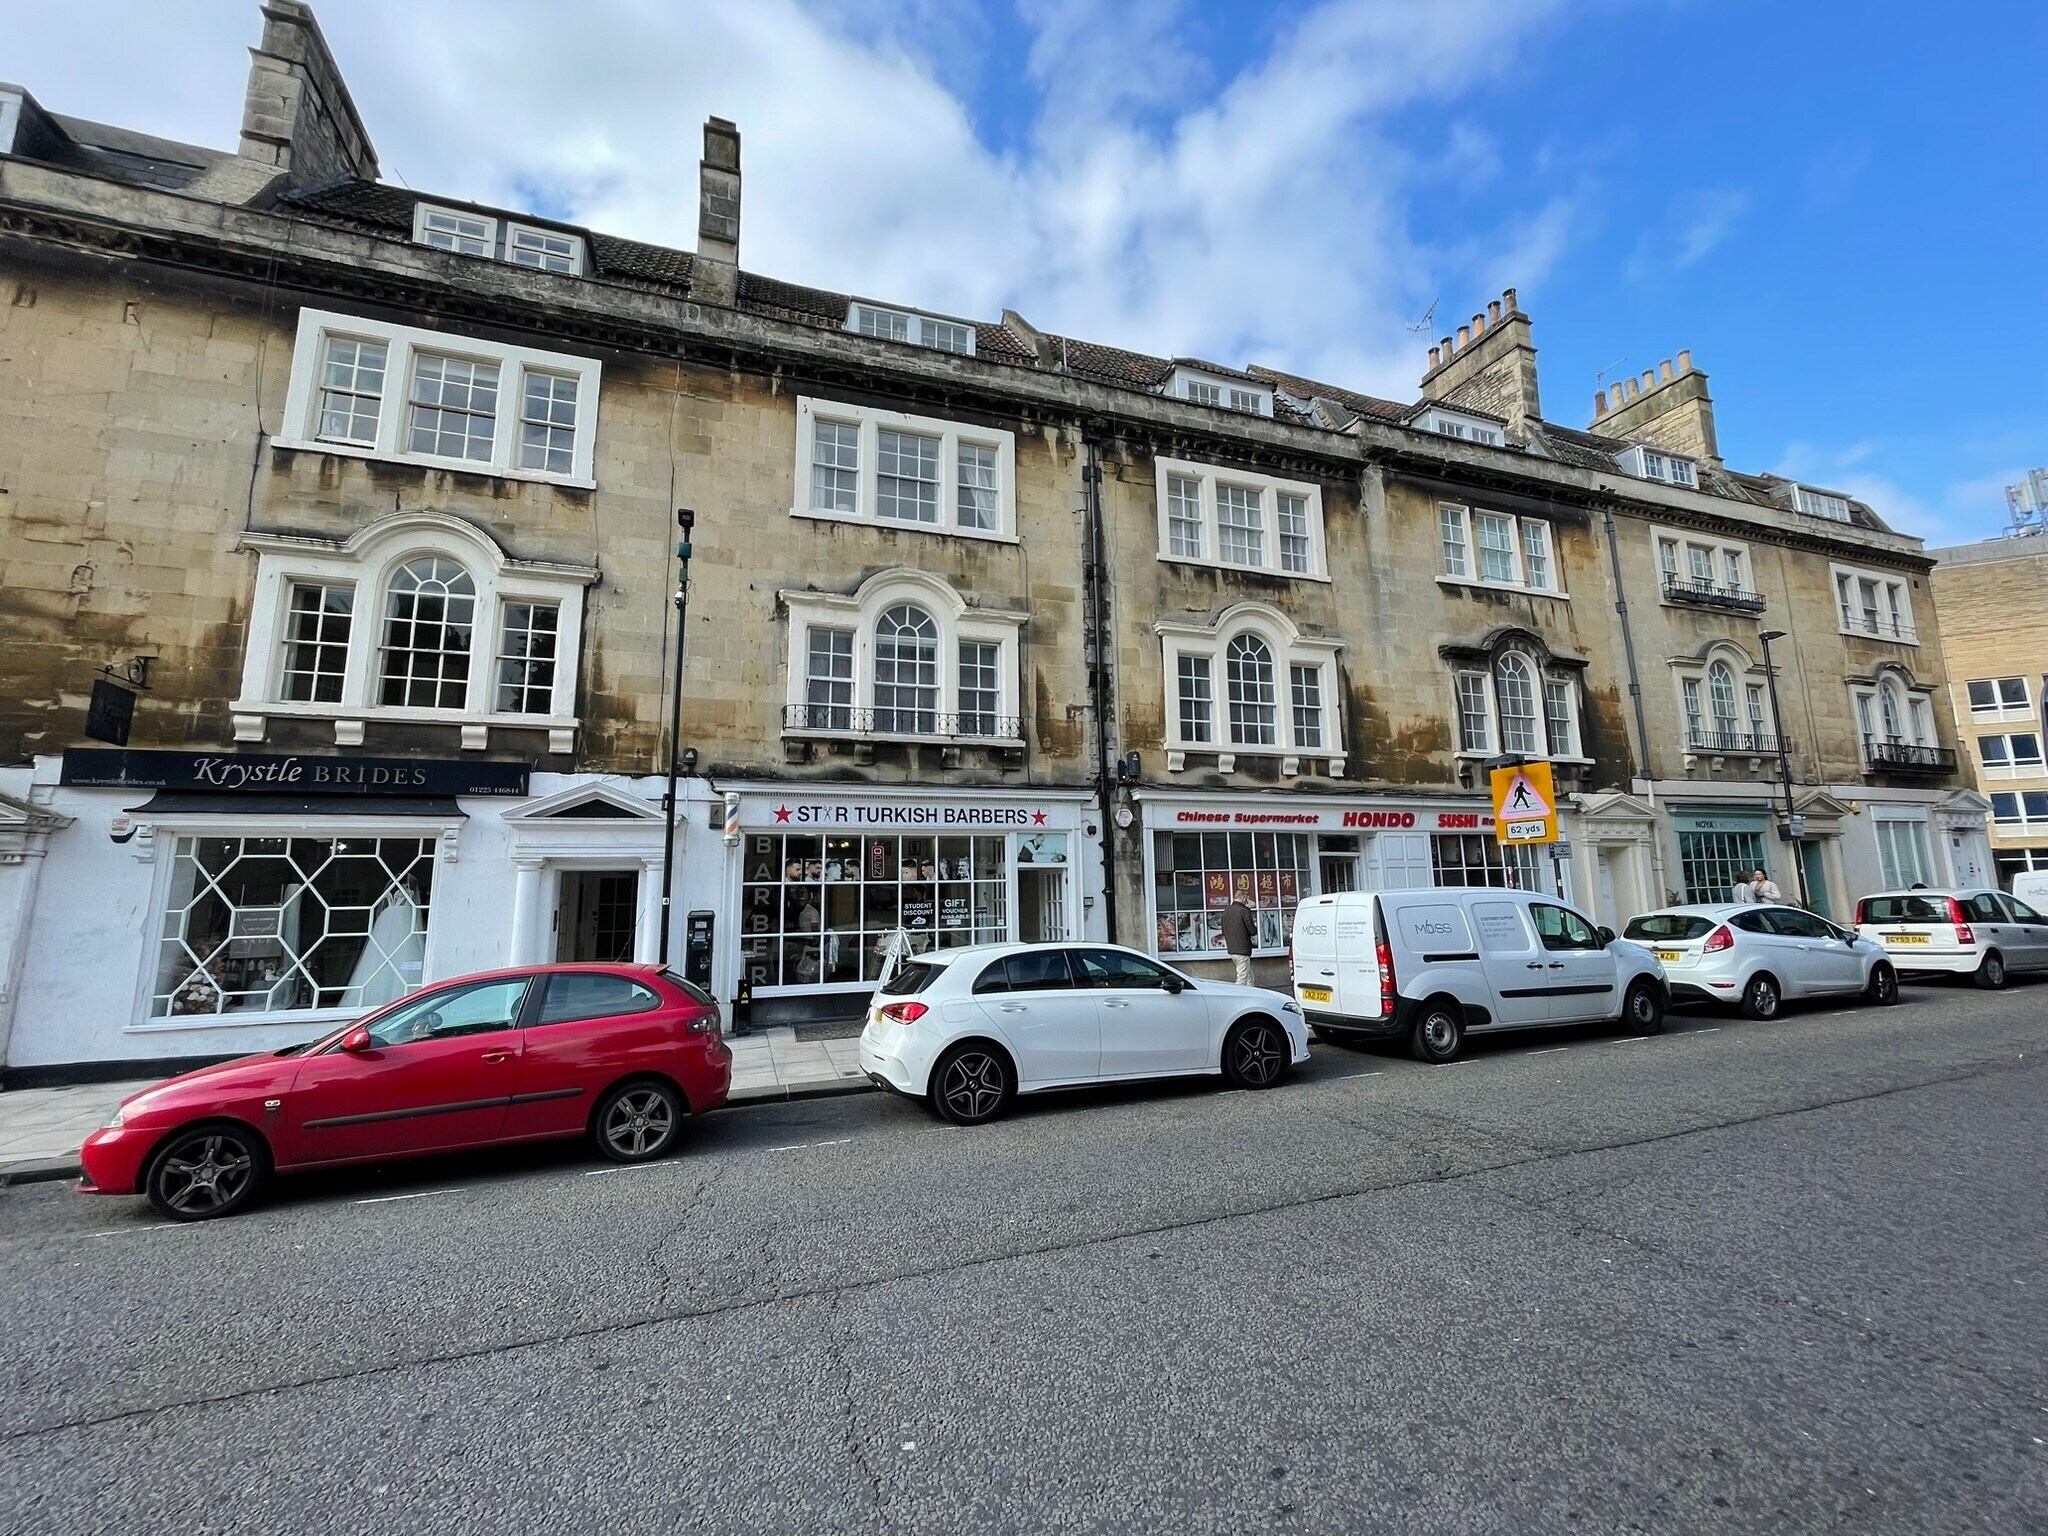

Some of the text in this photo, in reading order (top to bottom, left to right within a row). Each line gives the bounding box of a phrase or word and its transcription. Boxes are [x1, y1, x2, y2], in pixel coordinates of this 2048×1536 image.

[192, 757, 427, 789] Krystle BRIDES
[469, 786, 492, 794] 01225
[854, 806, 938, 824] TURKISH
[944, 808, 1028, 825] BARBERS
[1176, 811, 1231, 824] Chinese
[1234, 812, 1320, 826] Supermarket
[1343, 811, 1416, 828] HONDO
[1438, 813, 1479, 828] SUSHI
[1510, 824, 1541, 835] 62 yds
[873, 847, 882, 876] OPEN
[751, 835, 773, 985] BARBER
[904, 902, 933, 910] STUDENT
[944, 898, 967, 908] GIFT
